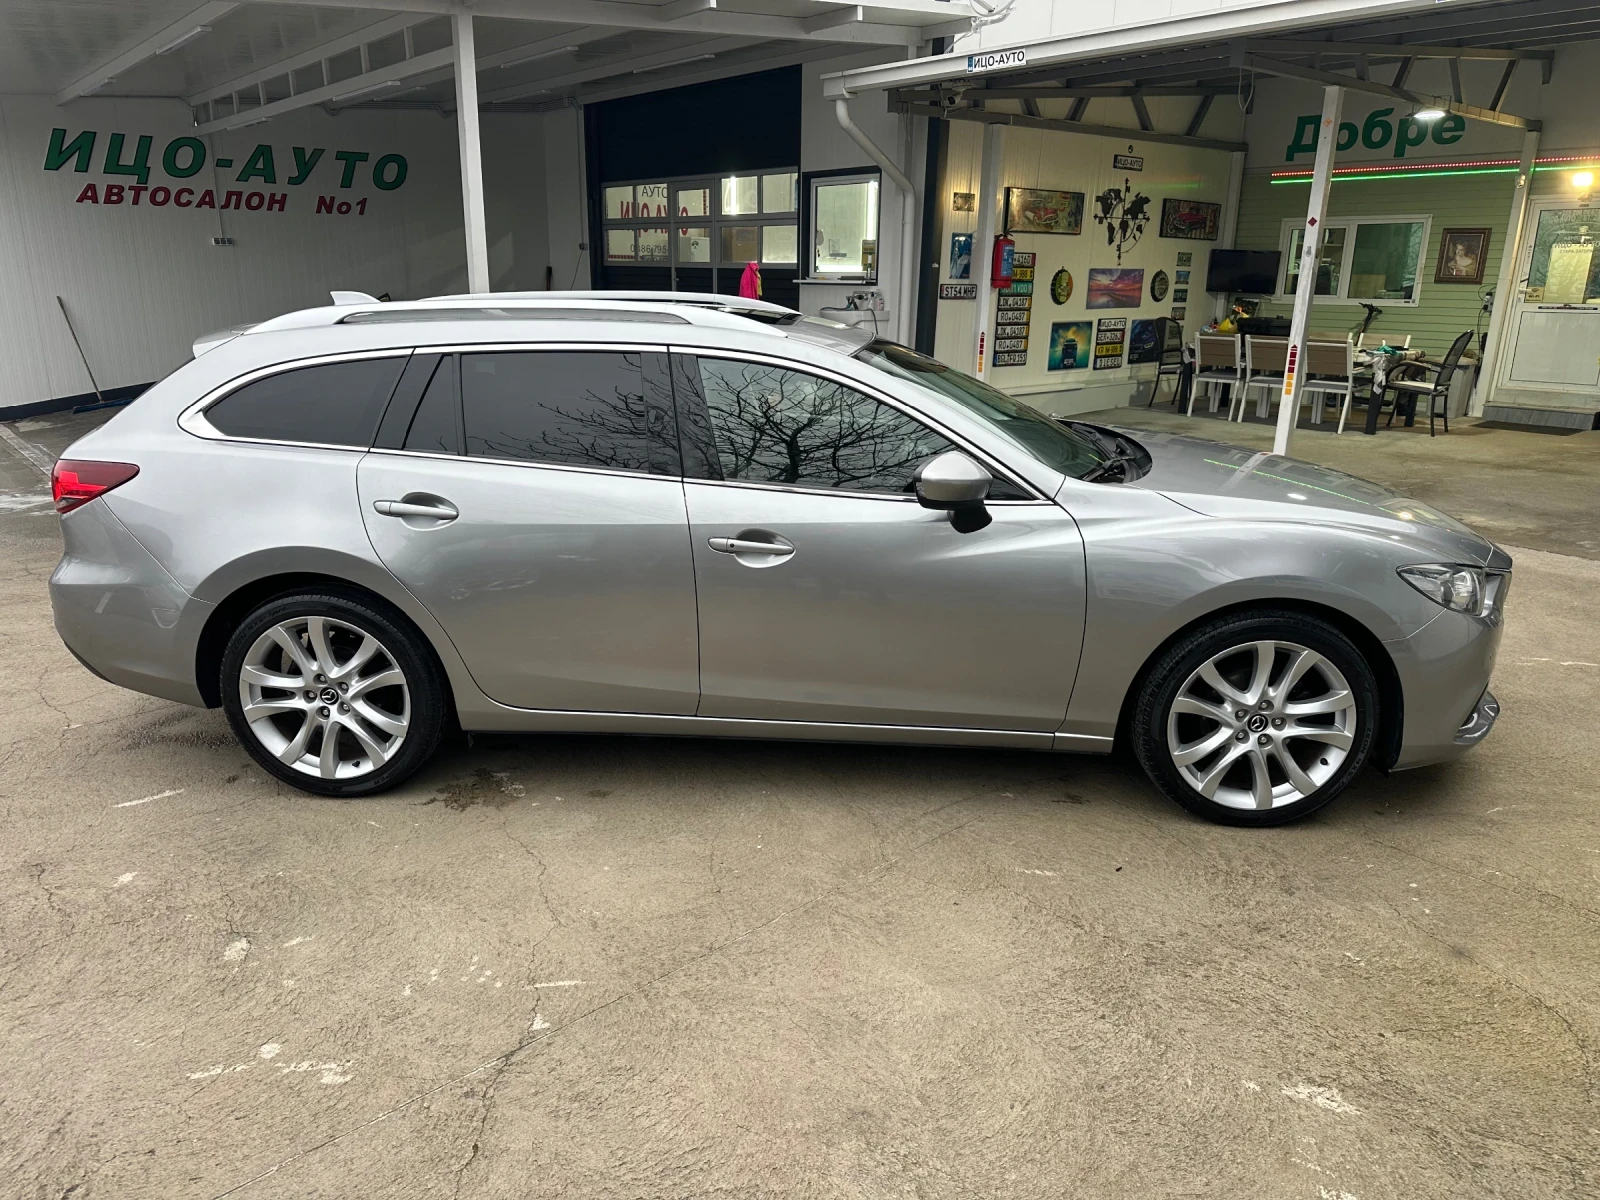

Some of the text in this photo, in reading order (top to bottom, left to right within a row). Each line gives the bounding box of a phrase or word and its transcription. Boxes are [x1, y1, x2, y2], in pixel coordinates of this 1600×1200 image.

[974, 50, 1025, 69] ИЦО-АУТО
[1285, 107, 1466, 161] Добре
[43, 127, 409, 191] ИЦО-АУТО
[76, 182, 368, 215] АВТОСАЛОН No1
